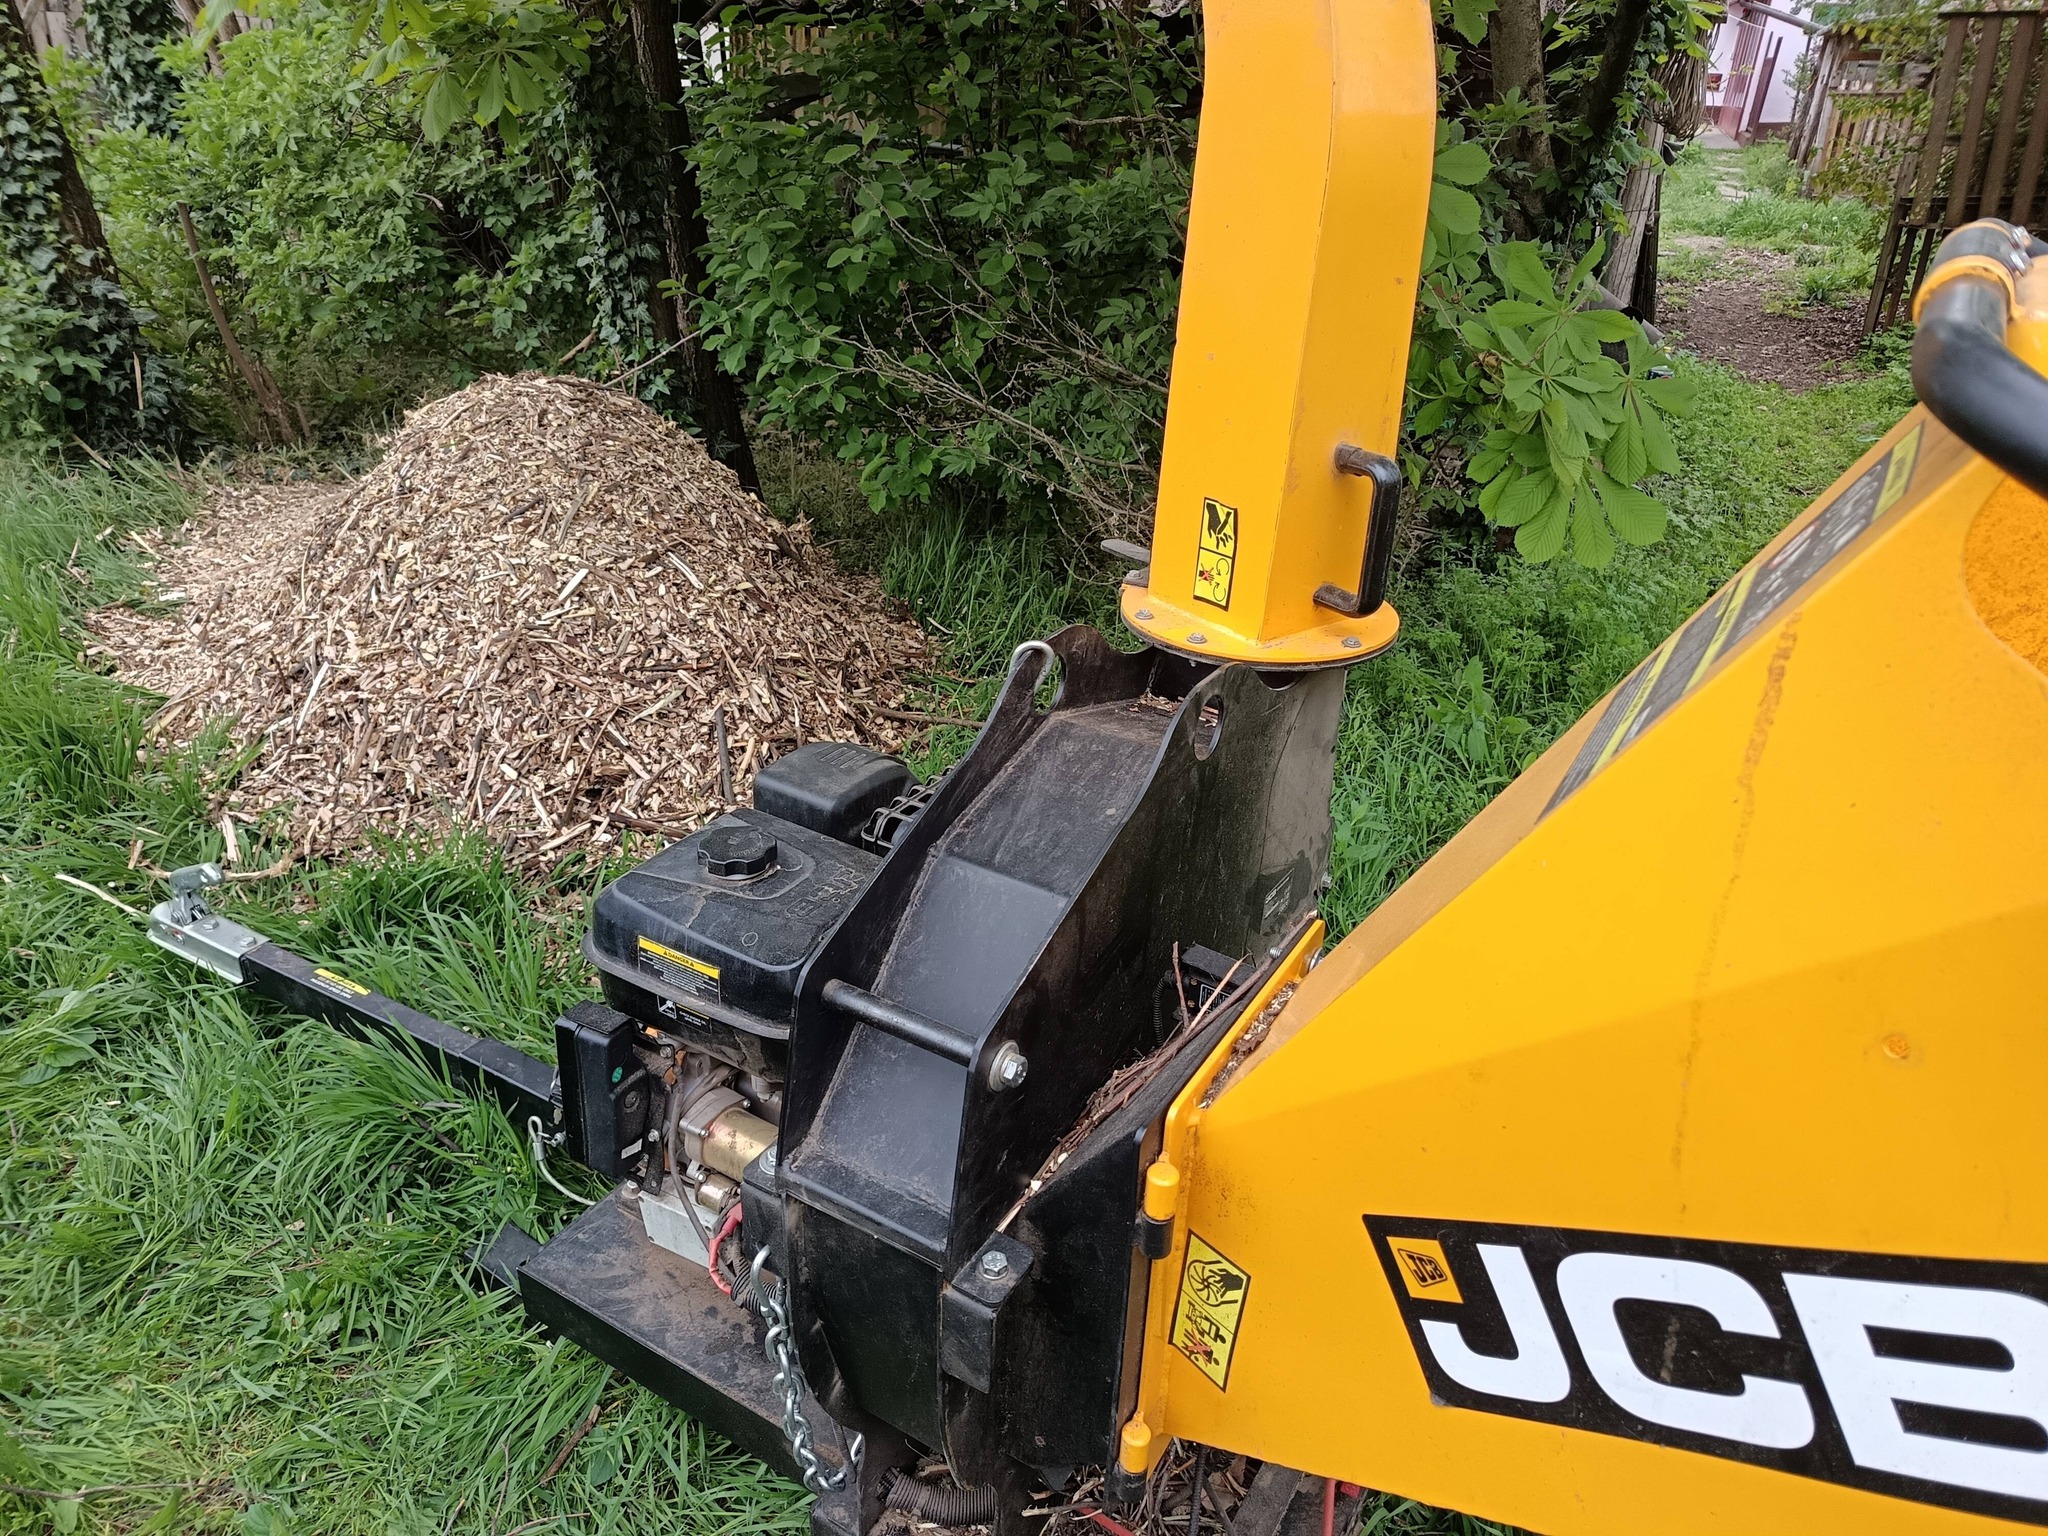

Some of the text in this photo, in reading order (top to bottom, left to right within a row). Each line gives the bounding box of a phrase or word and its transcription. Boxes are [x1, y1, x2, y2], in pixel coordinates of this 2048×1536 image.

[668, 952, 690, 964] DANGER
[1406, 1253, 1444, 1283] JCB
[1420, 1243, 2048, 1500] JCB
